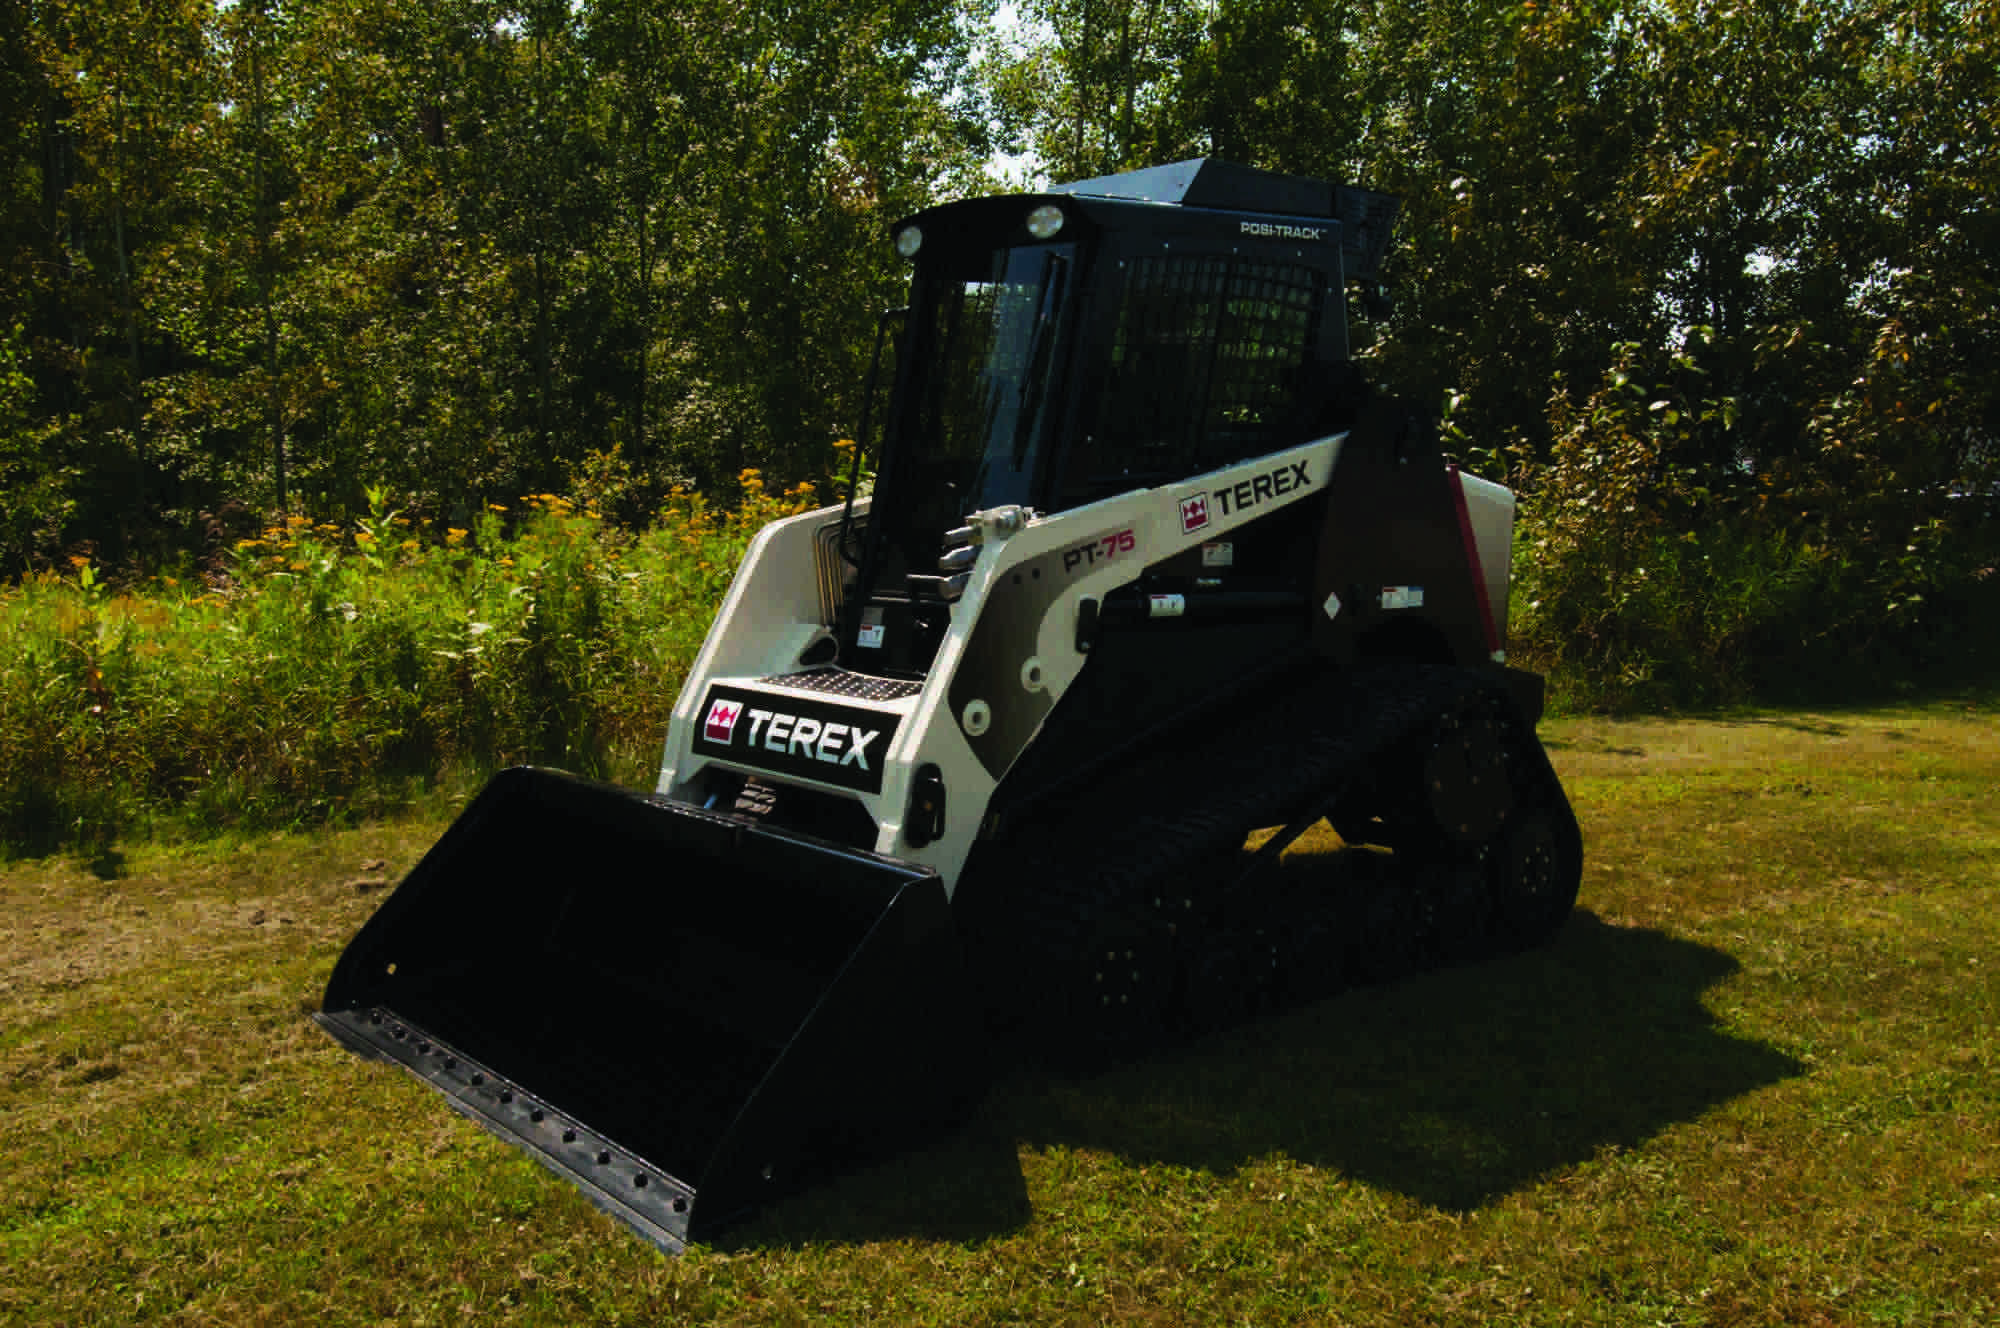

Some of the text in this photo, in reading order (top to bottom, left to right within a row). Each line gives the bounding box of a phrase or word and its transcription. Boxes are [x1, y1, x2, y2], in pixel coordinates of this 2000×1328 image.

[1214, 460, 1311, 515] TEREX
[1063, 530, 1135, 573] PT-75
[746, 709, 880, 770] TEREX
